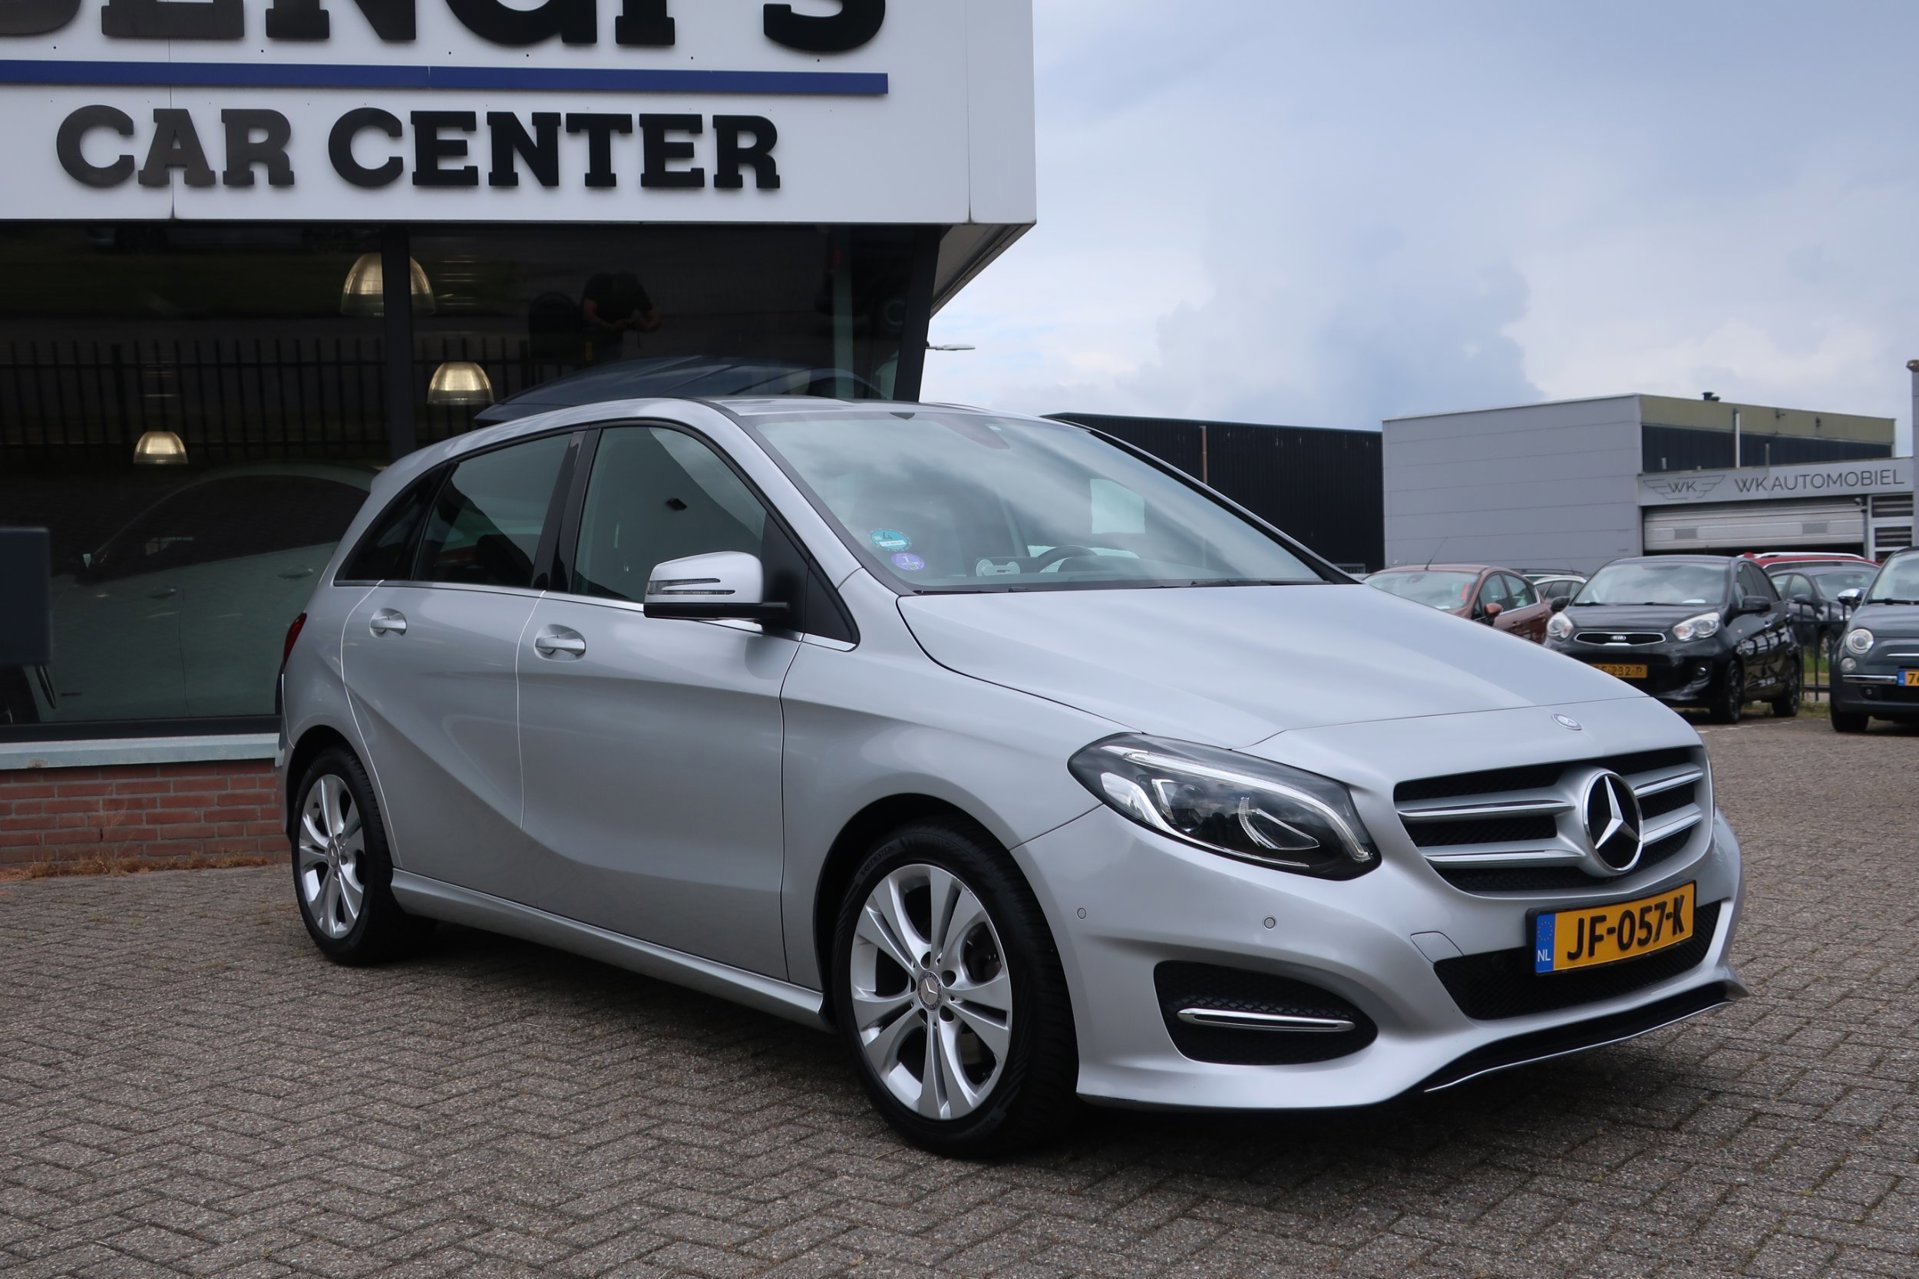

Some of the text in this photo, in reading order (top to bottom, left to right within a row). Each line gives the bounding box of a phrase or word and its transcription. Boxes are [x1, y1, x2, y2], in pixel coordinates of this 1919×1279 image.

[56, 104, 780, 189] CAR CENTER
[1668, 480, 1697, 493] WK
[1734, 469, 1905, 492] WK AUTOMOBIEL
[1567, 894, 1685, 961] JF-057-K
[1537, 949, 1551, 962] NL
